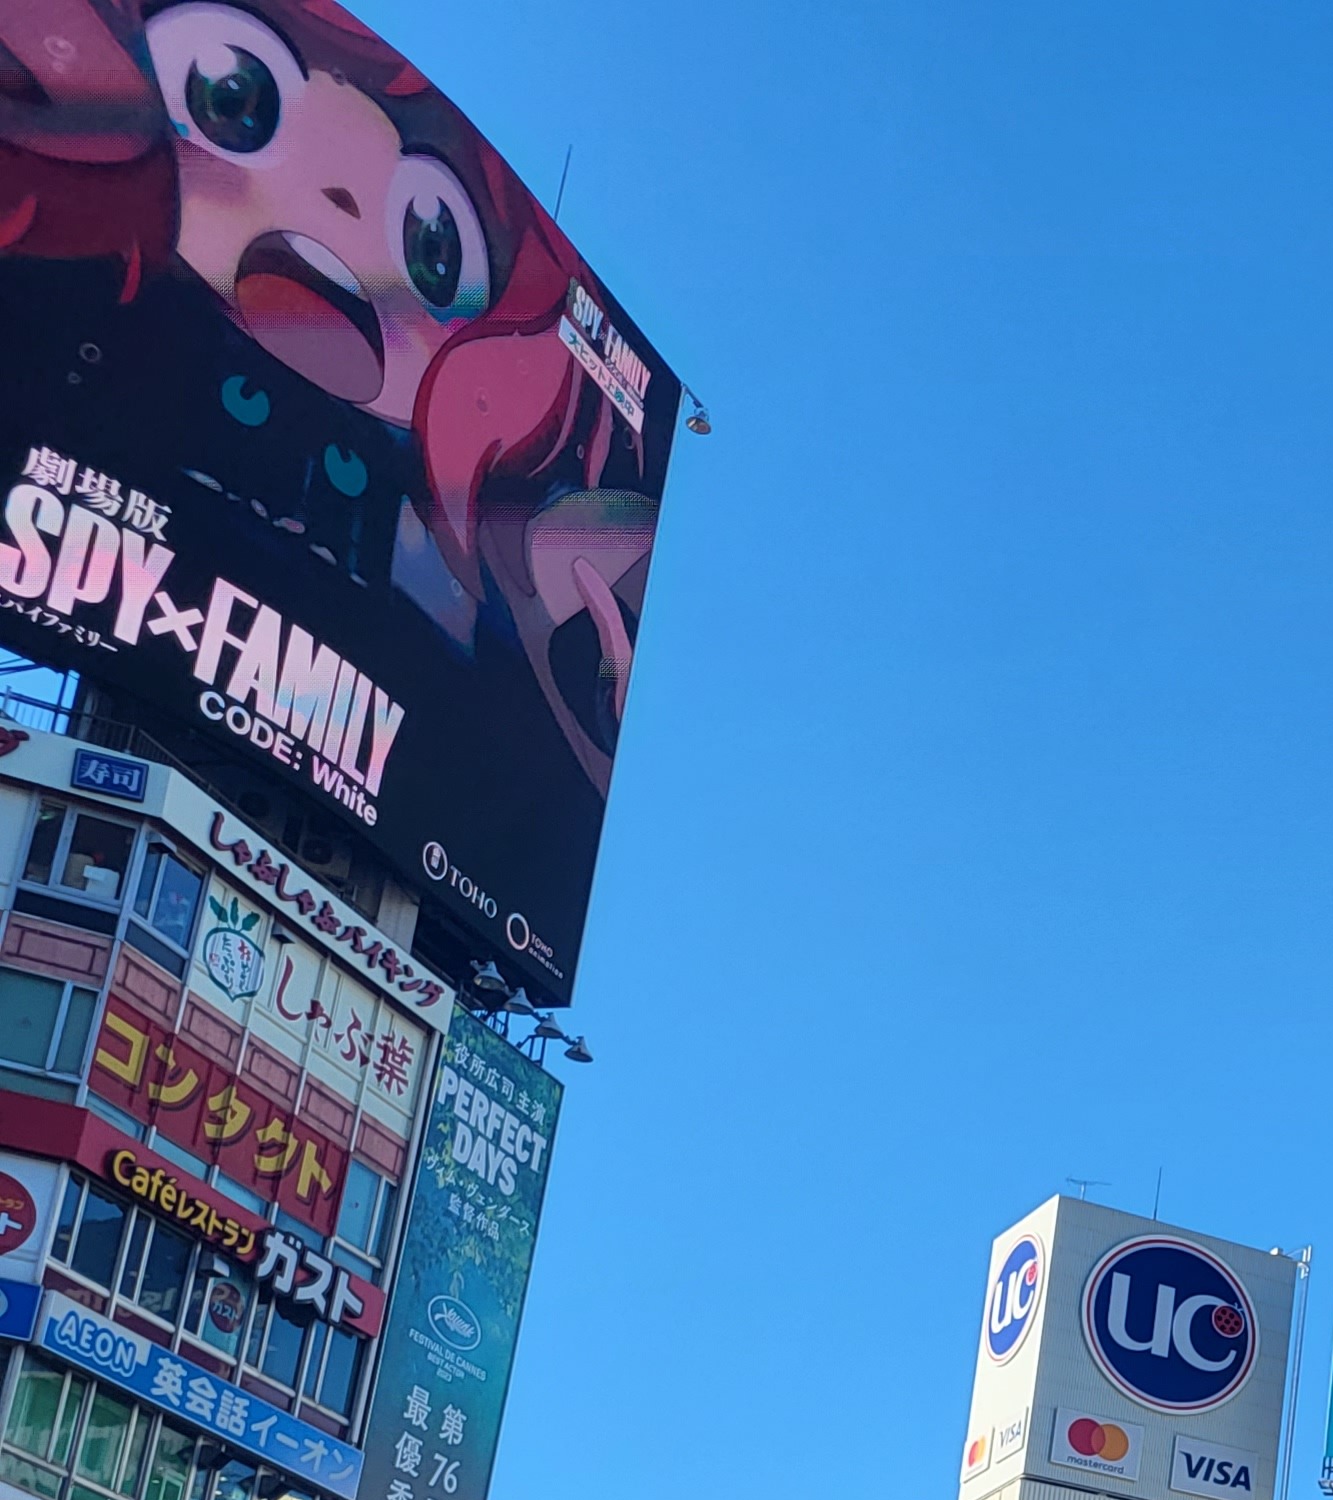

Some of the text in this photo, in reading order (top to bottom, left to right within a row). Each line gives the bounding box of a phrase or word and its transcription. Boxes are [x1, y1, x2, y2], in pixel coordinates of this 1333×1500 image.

[22, 446, 173, 542] 劇場版
[0, 594, 118, 652] パイファミリー
[80, 757, 140, 791] 寿司
[199, 690, 378, 826] CODE: White
[208, 811, 445, 1007] しゃぶしゃぶバイキング
[450, 865, 498, 919] TOHO
[531, 933, 553, 957] TOHO
[276, 955, 414, 1096] しゃぶ葉
[95, 1012, 332, 1198] コンタクト
[437, 1066, 547, 1174] PERFECT
[453, 1043, 547, 1126] 役所広司 主演
[427, 1152, 531, 1237] ヴィム・ヴェンダース
[451, 1123, 519, 1196] DAYS
[447, 1193, 500, 1241] 監督作品
[256, 1232, 363, 1323] ガスト
[991, 1259, 1037, 1334] UC
[57, 1312, 138, 1376] AEON
[409, 1328, 486, 1381] FESTIVAL DE CANNES
[1108, 1271, 1238, 1371] UC
[999, 1419, 1022, 1448] VISA
[1067, 1455, 1124, 1475] mastercard
[1179, 1451, 1252, 1491] VISA
